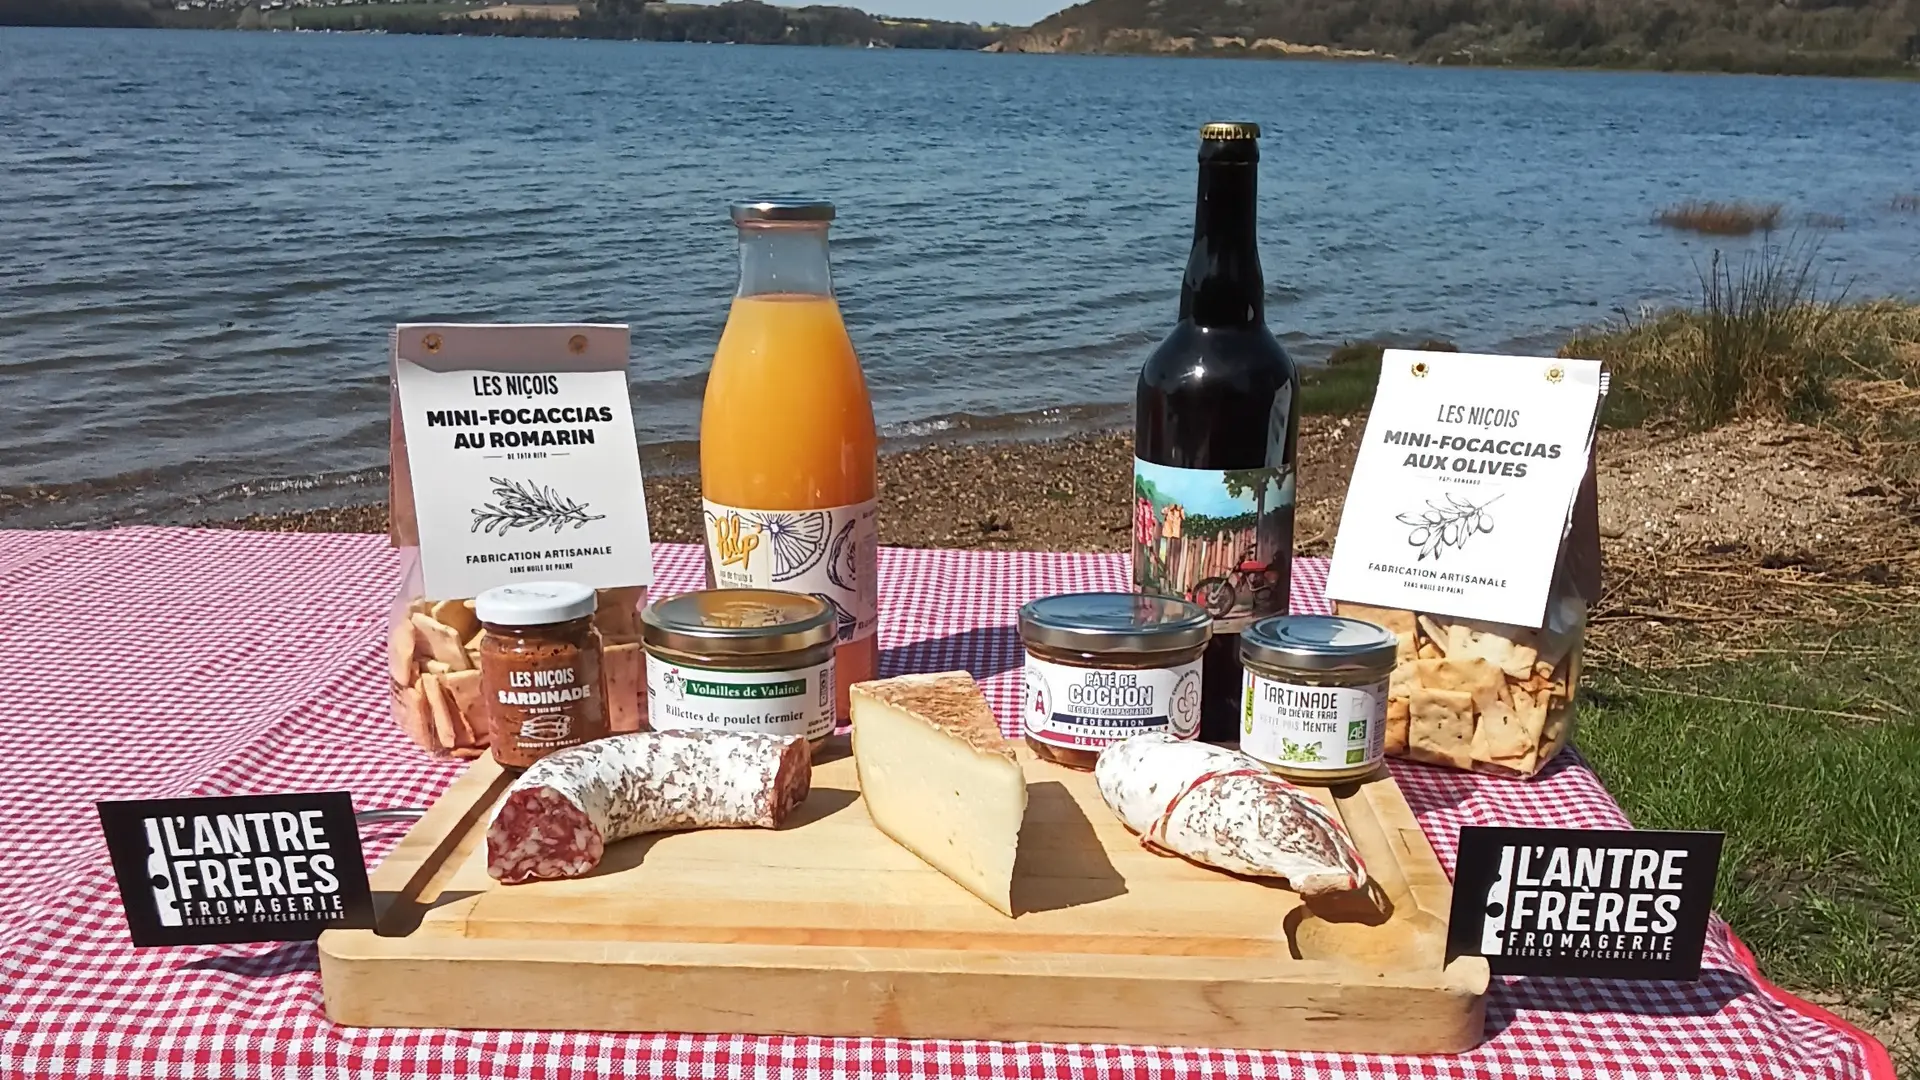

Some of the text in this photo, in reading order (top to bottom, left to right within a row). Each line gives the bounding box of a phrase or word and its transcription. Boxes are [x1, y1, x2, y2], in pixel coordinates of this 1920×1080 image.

[473, 375, 559, 399] LES NIÇOIS
[426, 406, 613, 427] MINI-FOCACCIAS
[1437, 404, 1520, 430] LES NIÇOIS
[454, 429, 595, 449] AU ROMARIN
[1384, 430, 1561, 459] MINI-FOCACCIAS
[1403, 453, 1528, 477] AUX OLIVES
[466, 546, 612, 564] FABRICATION ARTISANALE
[554, 562, 573, 571] PALME
[1368, 562, 1507, 588] FABRICATION ARTISANALE
[509, 668, 575, 688] LES NIÇOIS
[1085, 671, 1137, 687] PÂTÉ DE
[498, 685, 590, 705] SARDINADE
[691, 682, 801, 697] Volailles de Valaine
[1069, 684, 1153, 706] COCHON
[1263, 682, 1338, 709] TARTINADE
[665, 704, 704, 722] Rillettes
[706, 712, 720, 723] de
[723, 711, 761, 726] poulet
[764, 711, 804, 724] fermier
[1278, 706, 1287, 715] AU
[1318, 711, 1338, 719] FRAIS
[1075, 737, 1088, 745] DE
[1349, 726, 1364, 740] AB
[162, 810, 330, 856] L'ANTRE
[173, 851, 339, 899] FRÈRES
[1516, 846, 1688, 890] L'ANTRE
[184, 895, 344, 916] FROMAGERIE
[317, 910, 345, 921] FINE
[1510, 886, 1681, 934] FRÈRES
[1509, 931, 1673, 951] FROMAGERIE
[1574, 948, 1634, 960] ÉPICERIE
[1642, 951, 1671, 961] FINE
